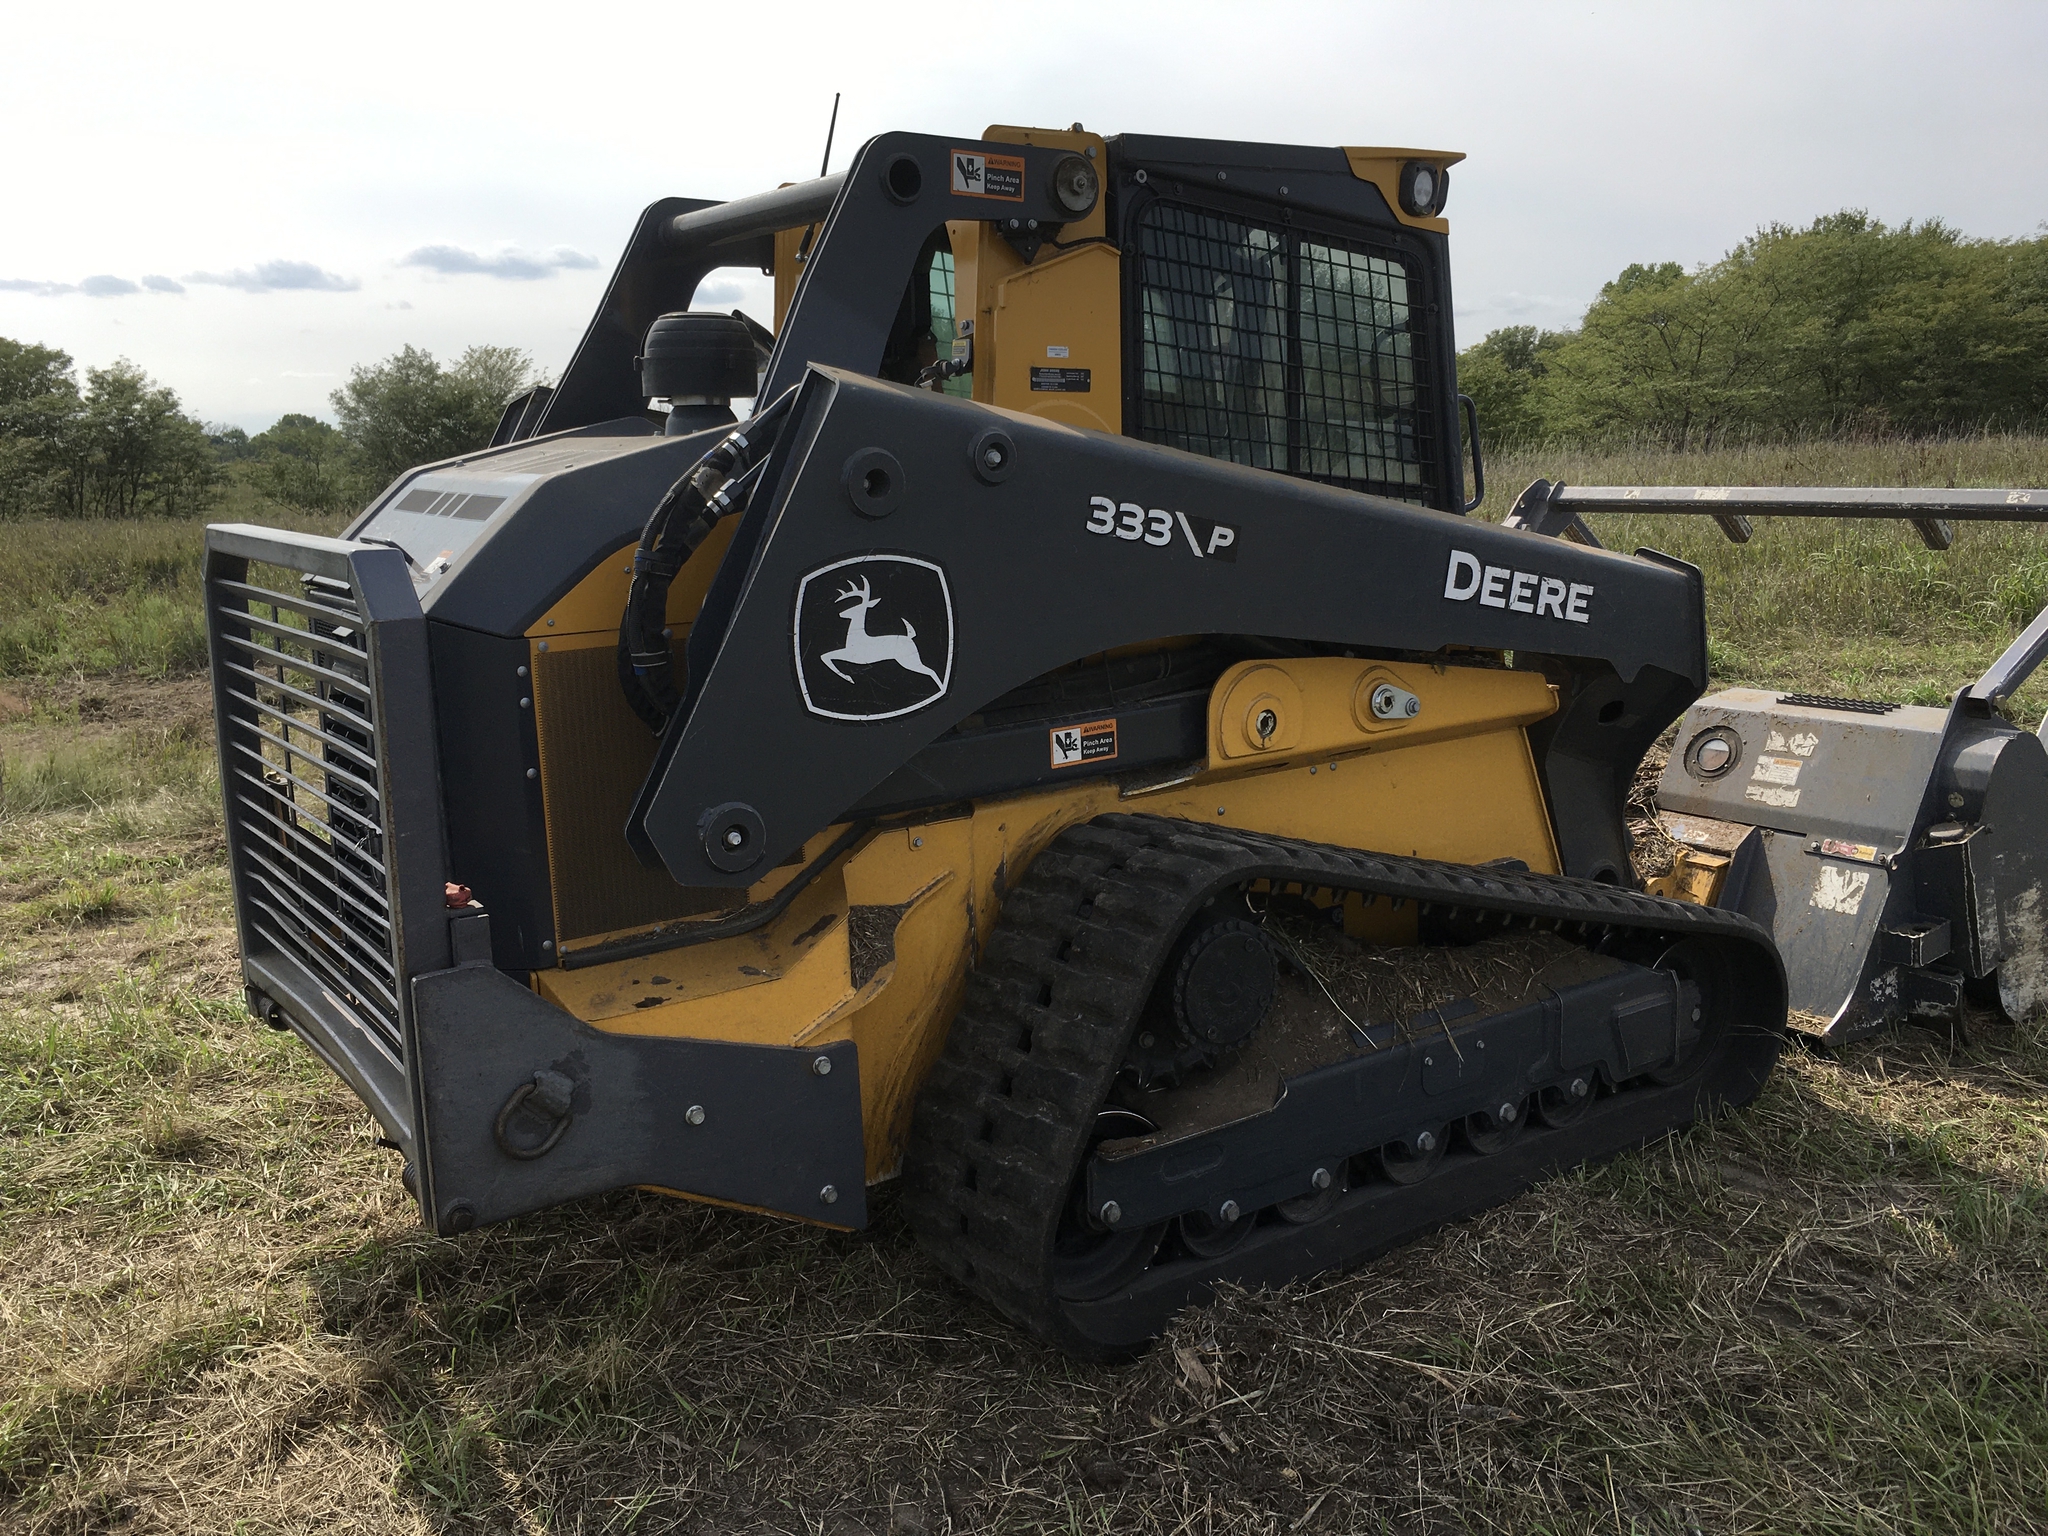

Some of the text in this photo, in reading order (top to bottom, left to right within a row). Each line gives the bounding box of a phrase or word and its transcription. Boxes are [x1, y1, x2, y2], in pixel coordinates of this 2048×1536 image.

[994, 159, 1021, 168] WARNING
[986, 173, 1020, 184] Pinch Area
[986, 183, 1015, 193] Keep Away
[1444, 549, 1595, 624] DEERE
[1088, 723, 1113, 732] WARNING
[1083, 739, 1099, 747] Pinch
